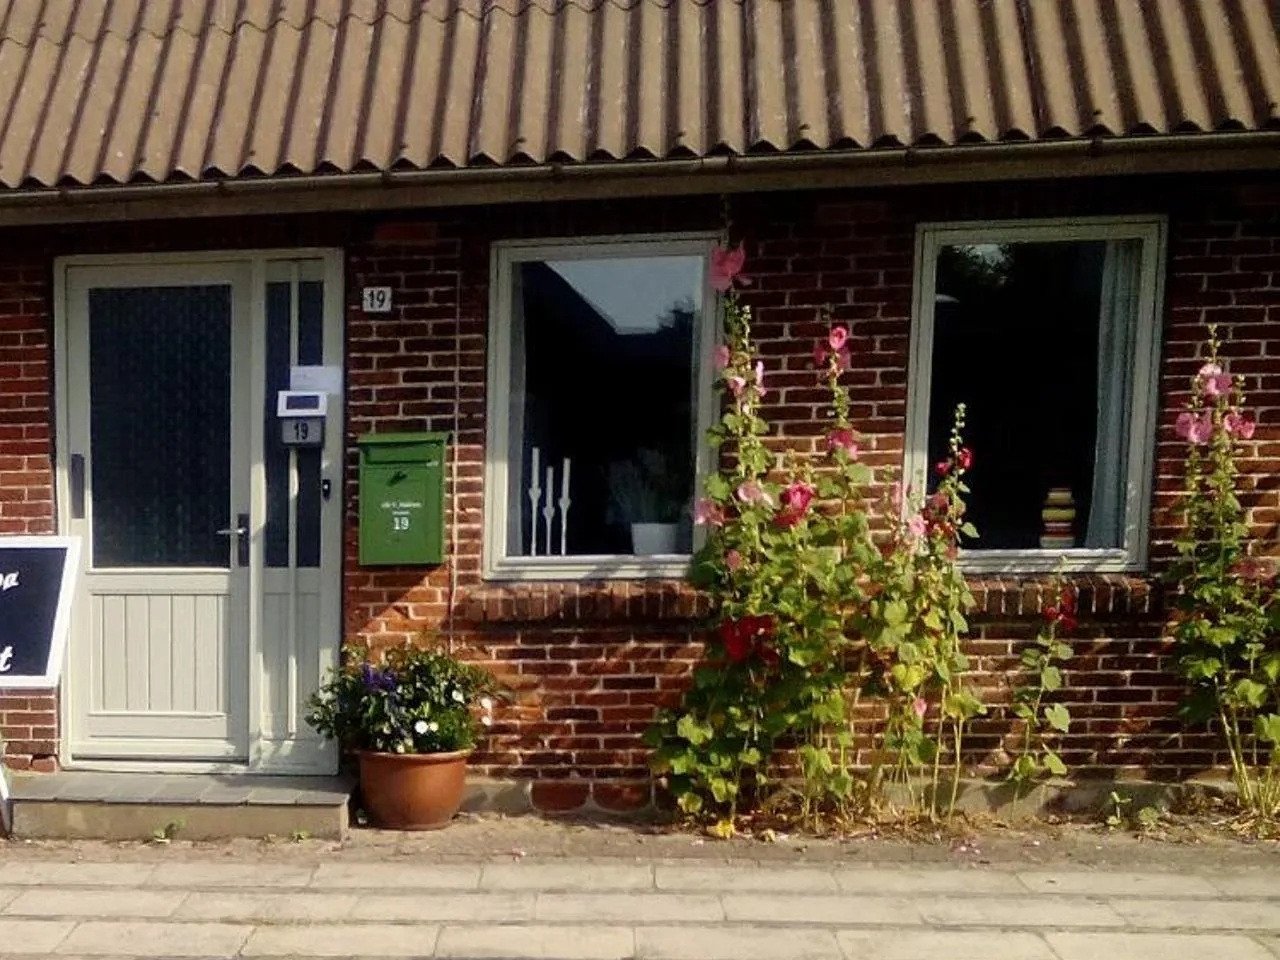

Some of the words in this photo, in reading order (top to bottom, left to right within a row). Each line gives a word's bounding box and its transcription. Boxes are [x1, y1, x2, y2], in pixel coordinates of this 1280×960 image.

[368, 289, 386, 309] 19
[293, 422, 309, 440] 19
[393, 516, 409, 530] 19
